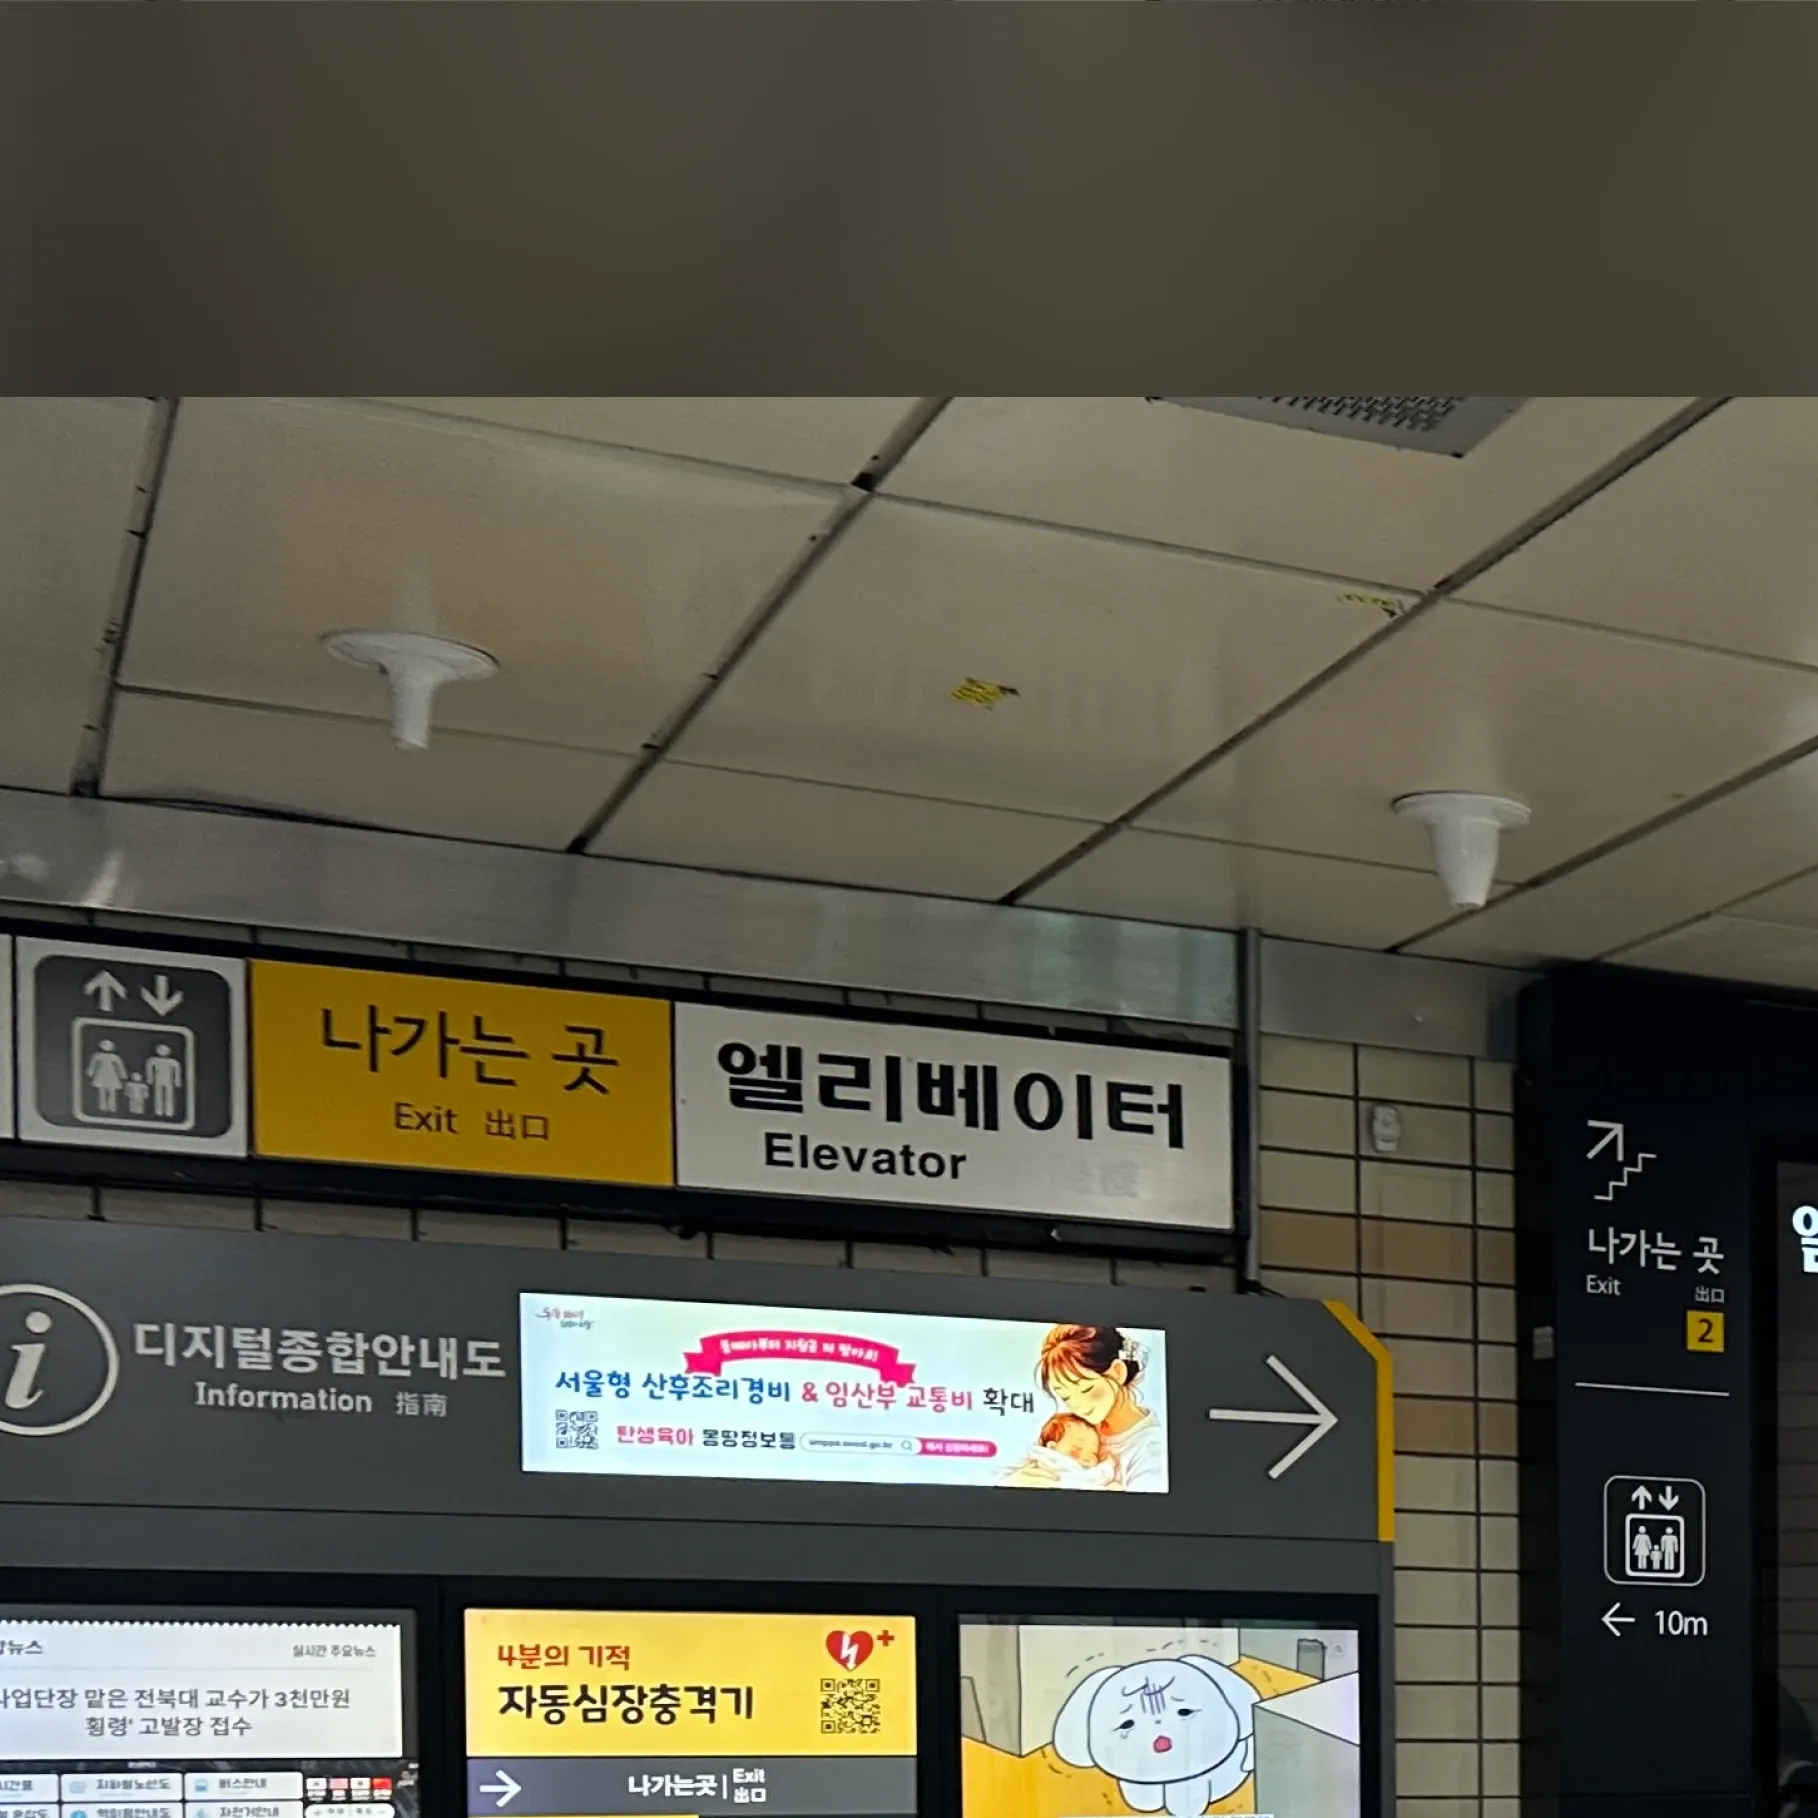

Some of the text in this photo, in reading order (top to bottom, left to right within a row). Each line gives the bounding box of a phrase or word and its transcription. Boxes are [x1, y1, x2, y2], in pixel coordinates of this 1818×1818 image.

[321, 1004, 619, 1095] 나가는 곳
[717, 1042, 1184, 1149] 엘리베이터
[394, 1101, 457, 1136] Exit
[485, 1109, 550, 1141] 出口
[764, 1131, 967, 1180] Elevator
[1588, 1227, 1725, 1275] 나가는 곳
[1586, 1274, 1622, 1295] Exit
[1694, 1285, 1725, 1303] 出口
[1697, 1318, 1714, 1343] 2
[134, 1320, 505, 1380] 디지털종합안내도
[195, 1381, 372, 1414] Information
[395, 1391, 448, 1418] 指南
[555, 1369, 1034, 1416] 서울형 산후조리경비 & 임산부 교통비 확대
[617, 1426, 693, 1446] 탄생육아
[1655, 1610, 1708, 1636] 10m
[498, 1644, 631, 1672] 4분의 기적
[135, 1688, 199, 1710] 전북대
[205, 1688, 269, 1710] 교수가
[274, 1688, 350, 1709] 3천만원
[498, 1683, 754, 1726] 자동심장충격기
[139, 1716, 204, 1737] 고발장
[210, 1716, 252, 1737] 접수
[628, 1774, 718, 1798] 나가는곳
[732, 1768, 766, 1784] Exit
[733, 1787, 767, 1803] 出口
